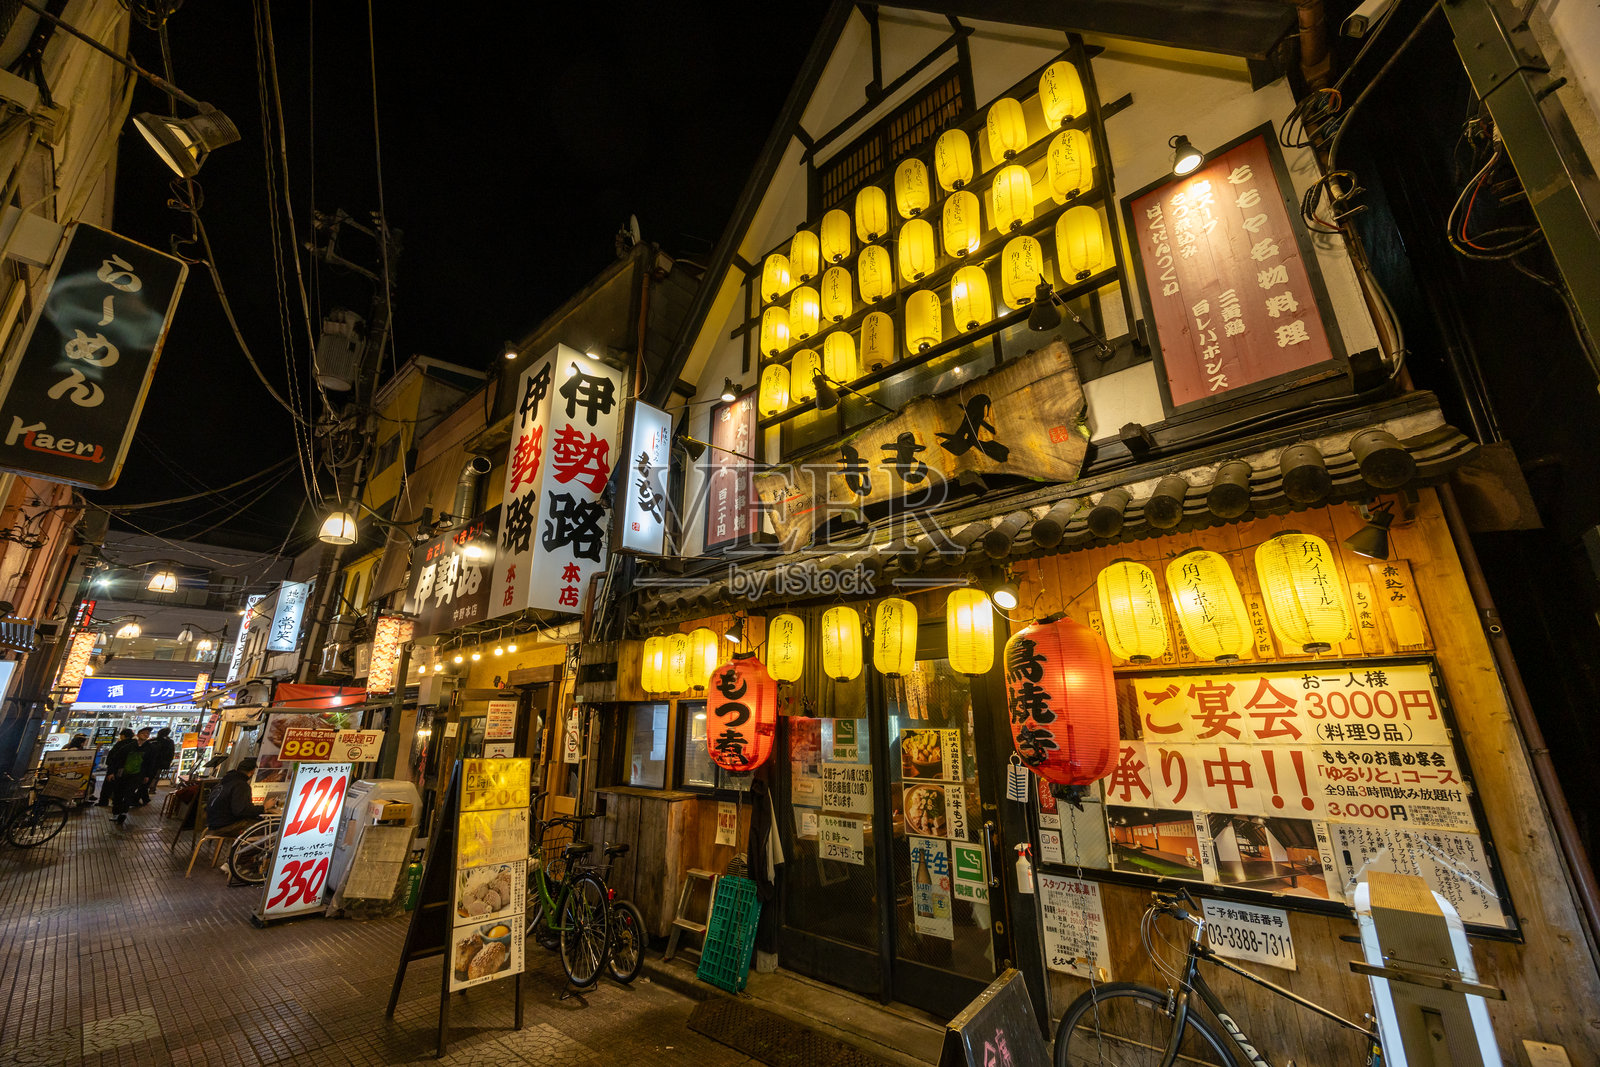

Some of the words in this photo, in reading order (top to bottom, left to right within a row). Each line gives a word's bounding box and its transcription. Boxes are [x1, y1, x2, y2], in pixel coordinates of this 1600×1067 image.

[1170, 192, 1198, 260] もつ煮込み
[1146, 202, 1180, 297] ばくだんつくね
[1227, 165, 1310, 348] ももや名物料理
[47, 254, 143, 408] らーめん
[1218, 288, 1246, 338] 三重鶏
[502, 361, 552, 556] 伊勢路
[542, 361, 617, 564] 伊勢路
[837, 394, 1010, 497] ももや
[425, 541, 446, 562] おでん
[413, 551, 483, 616] 伊勢路
[502, 563, 517, 607] 本店
[558, 562, 581, 608] 本店
[1182, 563, 1215, 625] 角ハイボール
[1302, 541, 1334, 606] 角ハイボール
[1382, 564, 1406, 602] 煮込み
[453, 604, 478, 622] 中野本店
[1140, 570, 1160, 626] 角ハイボール
[1356, 591, 1375, 629] もつ煮込
[881, 605, 893, 650] 角ハイボール
[108, 684, 124, 697] 酒
[1301, 670, 1389, 690] お一人様
[715, 669, 750, 766] もつ煮
[1143, 677, 1302, 741] ご宴会
[1307, 689, 1437, 721] 3000円
[284, 740, 331, 757] 980
[848, 748, 857, 757] OK
[1317, 764, 1459, 786] 「ゆるりと」コース
[1325, 784, 1462, 803] 全9品3時間飲み放題付
[952, 800, 965, 838] 牛もつ鍋
[1328, 802, 1408, 822] 3,000円
[1465, 839, 1478, 862] 生ビール
[975, 887, 988, 900] OK
[1207, 906, 1283, 927] ご予約電話番号
[1208, 923, 1293, 959] 03-3388-7311
